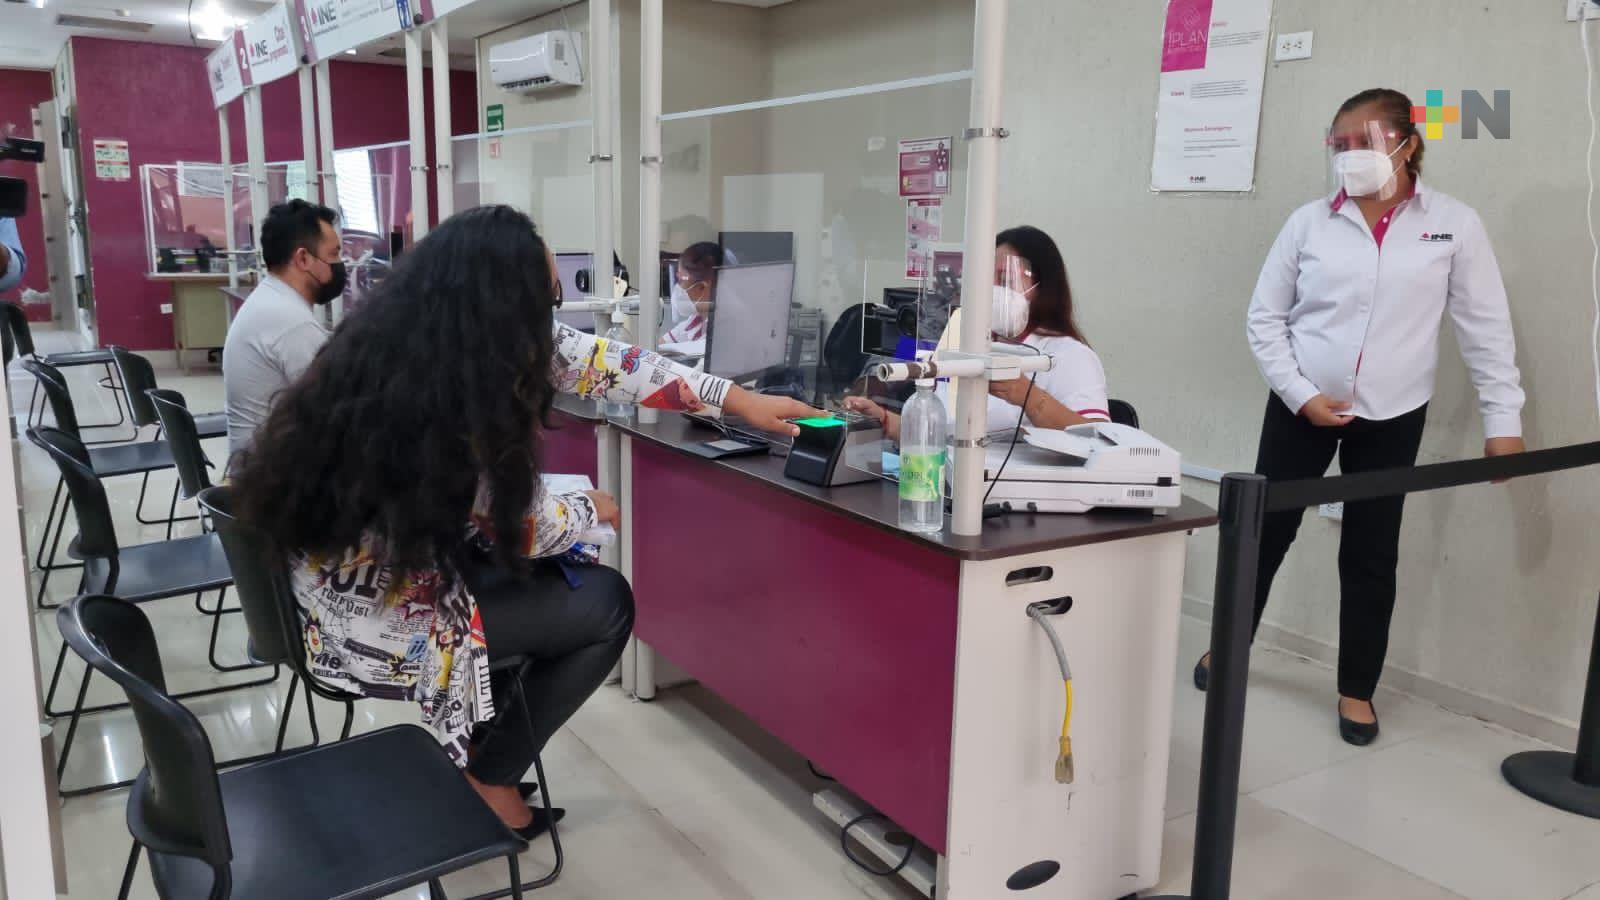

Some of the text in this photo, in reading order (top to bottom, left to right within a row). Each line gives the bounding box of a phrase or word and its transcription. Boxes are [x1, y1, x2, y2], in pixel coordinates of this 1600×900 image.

[318, 1, 337, 25] INE
[300, 15, 310, 42] 3
[240, 47, 249, 69] 2
[254, 39, 268, 57] INE
